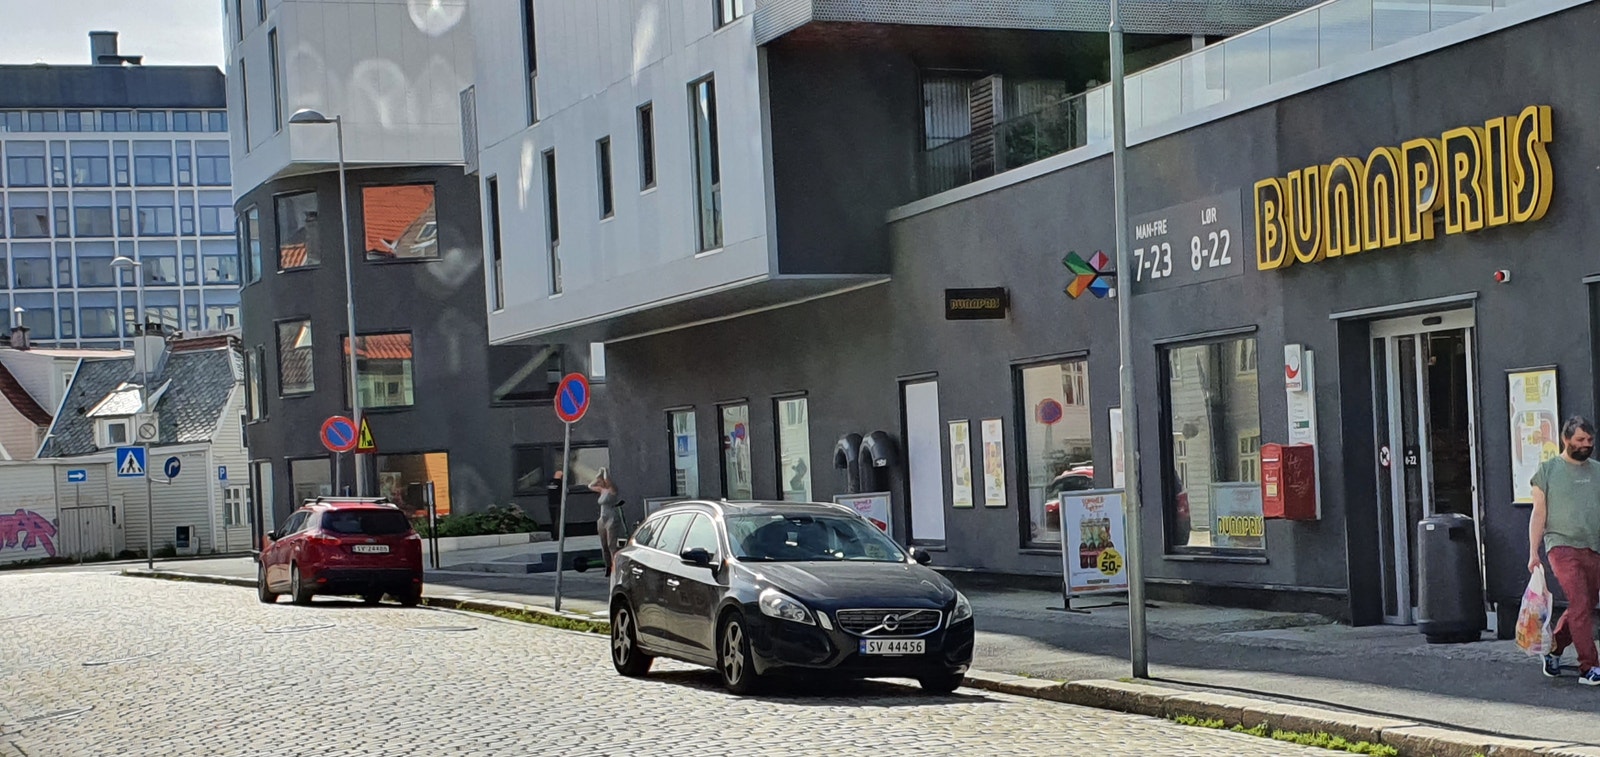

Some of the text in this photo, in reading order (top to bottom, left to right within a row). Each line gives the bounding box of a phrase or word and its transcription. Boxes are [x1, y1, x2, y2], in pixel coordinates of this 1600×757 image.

[1254, 105, 1553, 271] BUNNPRIS
[1201, 207, 1217, 225] LØR
[1135, 219, 1168, 240] MAN-FRE
[1190, 229, 1232, 271] 8-22
[1133, 242, 1172, 282] 7-23
[219, 467, 226, 479] P
[1102, 551, 1109, 561] 2
[869, 641, 923, 652] SV 44456
